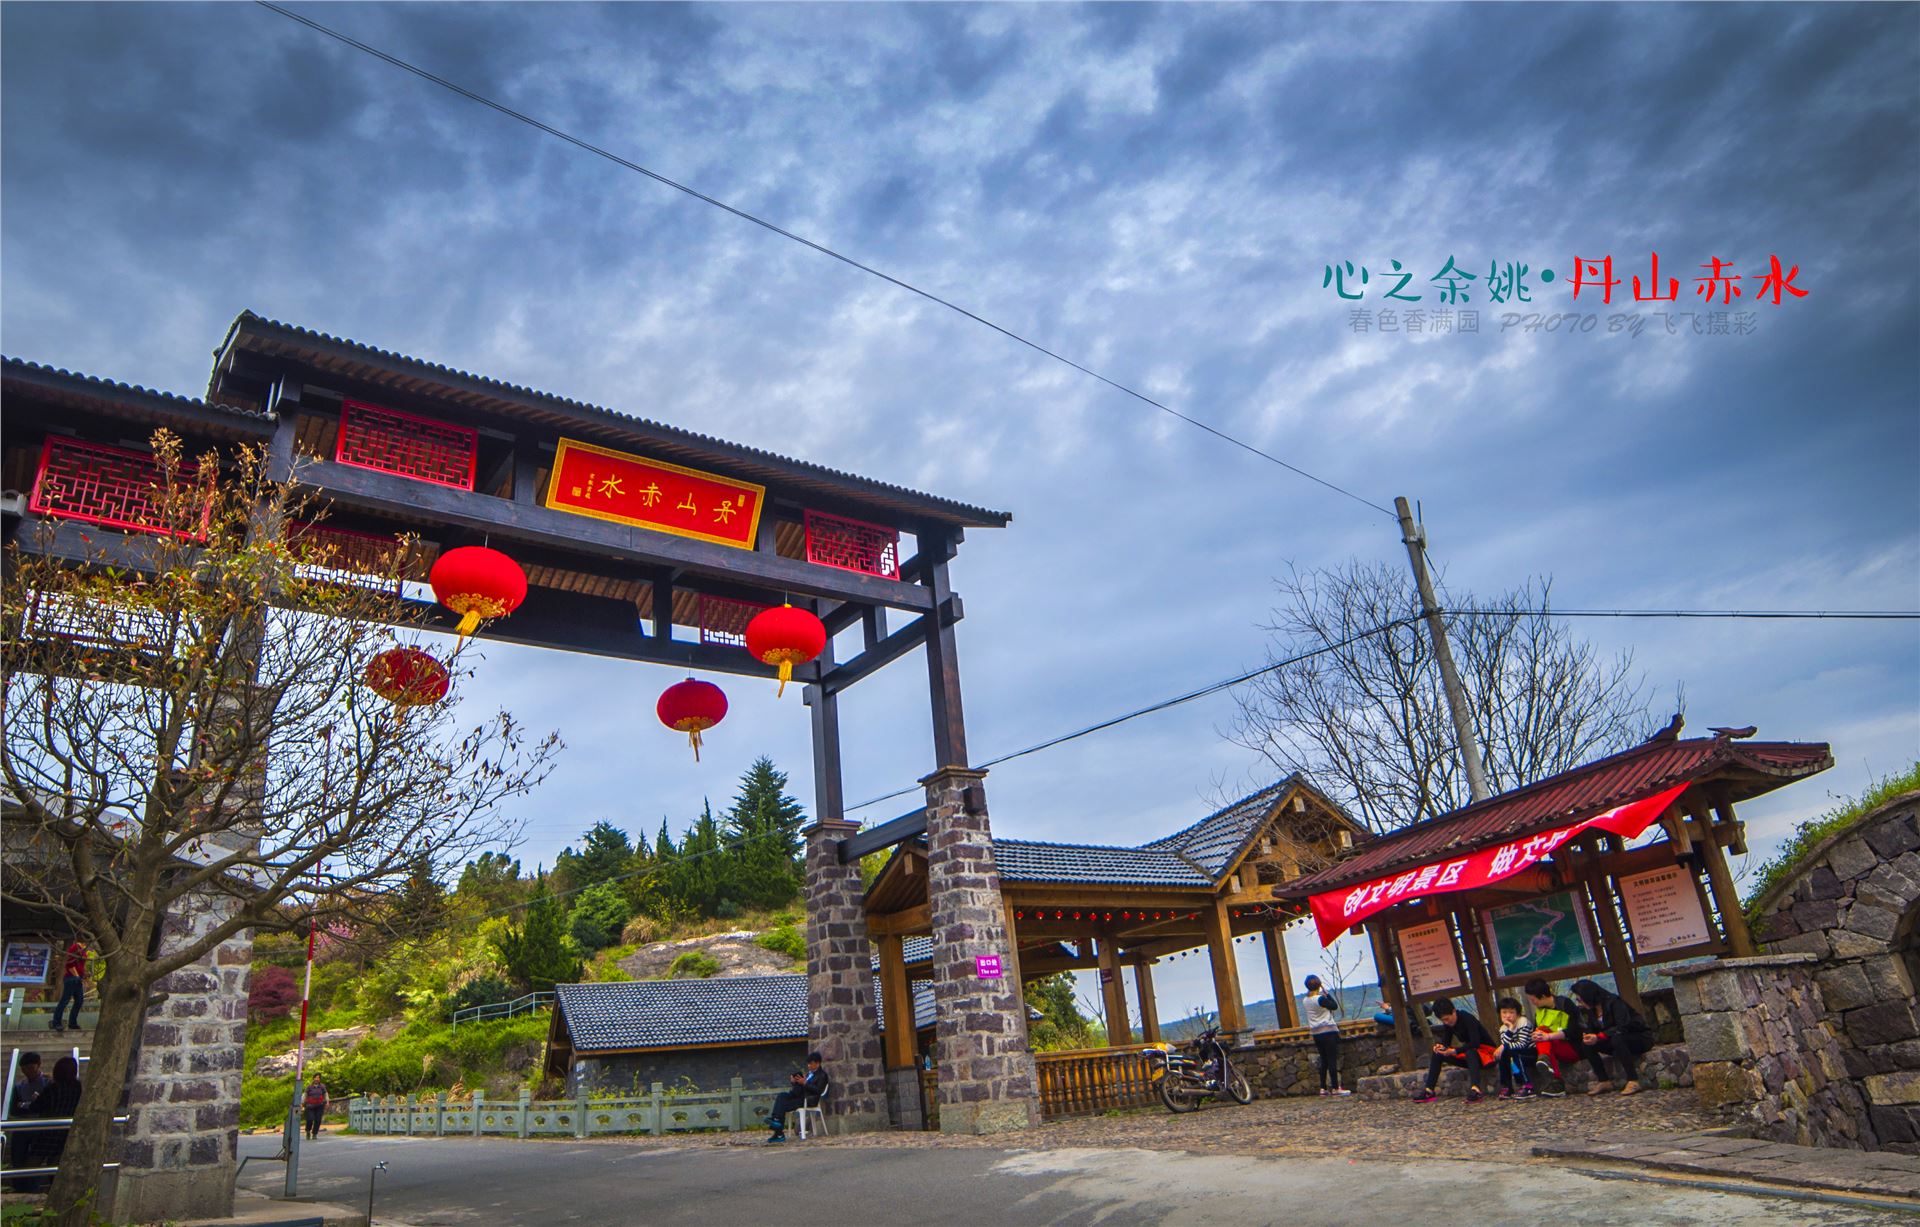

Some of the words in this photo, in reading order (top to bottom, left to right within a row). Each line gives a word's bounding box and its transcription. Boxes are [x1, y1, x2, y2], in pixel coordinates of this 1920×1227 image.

[1343, 859, 1469, 917] 创文明景区
